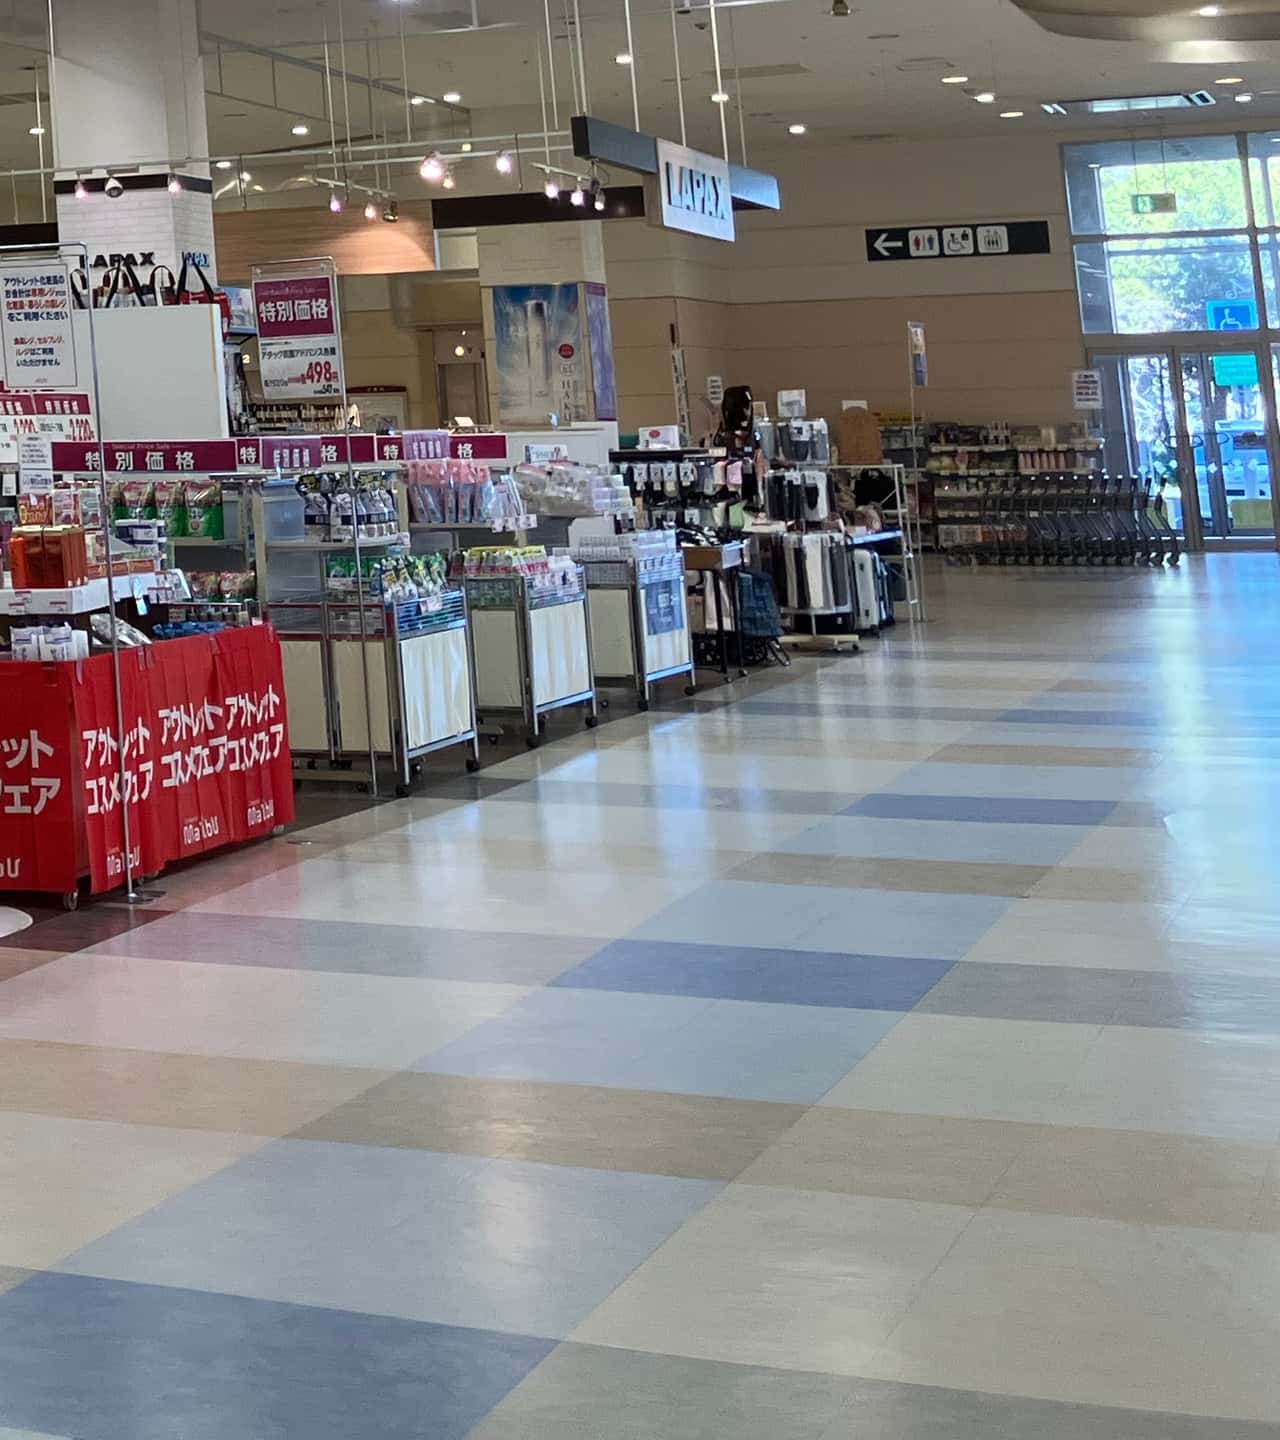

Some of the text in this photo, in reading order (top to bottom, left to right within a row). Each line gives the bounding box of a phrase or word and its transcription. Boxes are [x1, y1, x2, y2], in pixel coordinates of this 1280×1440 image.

[665, 160, 727, 220] LAPAX
[259, 298, 329, 323] 特別価格
[85, 451, 195, 471] 特別価格
[159, 695, 224, 745] アウトレット
[225, 683, 280, 731] アウトレット
[161, 735, 228, 788] コスメフェア
[227, 723, 284, 772] コスメフェア
[107, 845, 141, 876] Malbu
